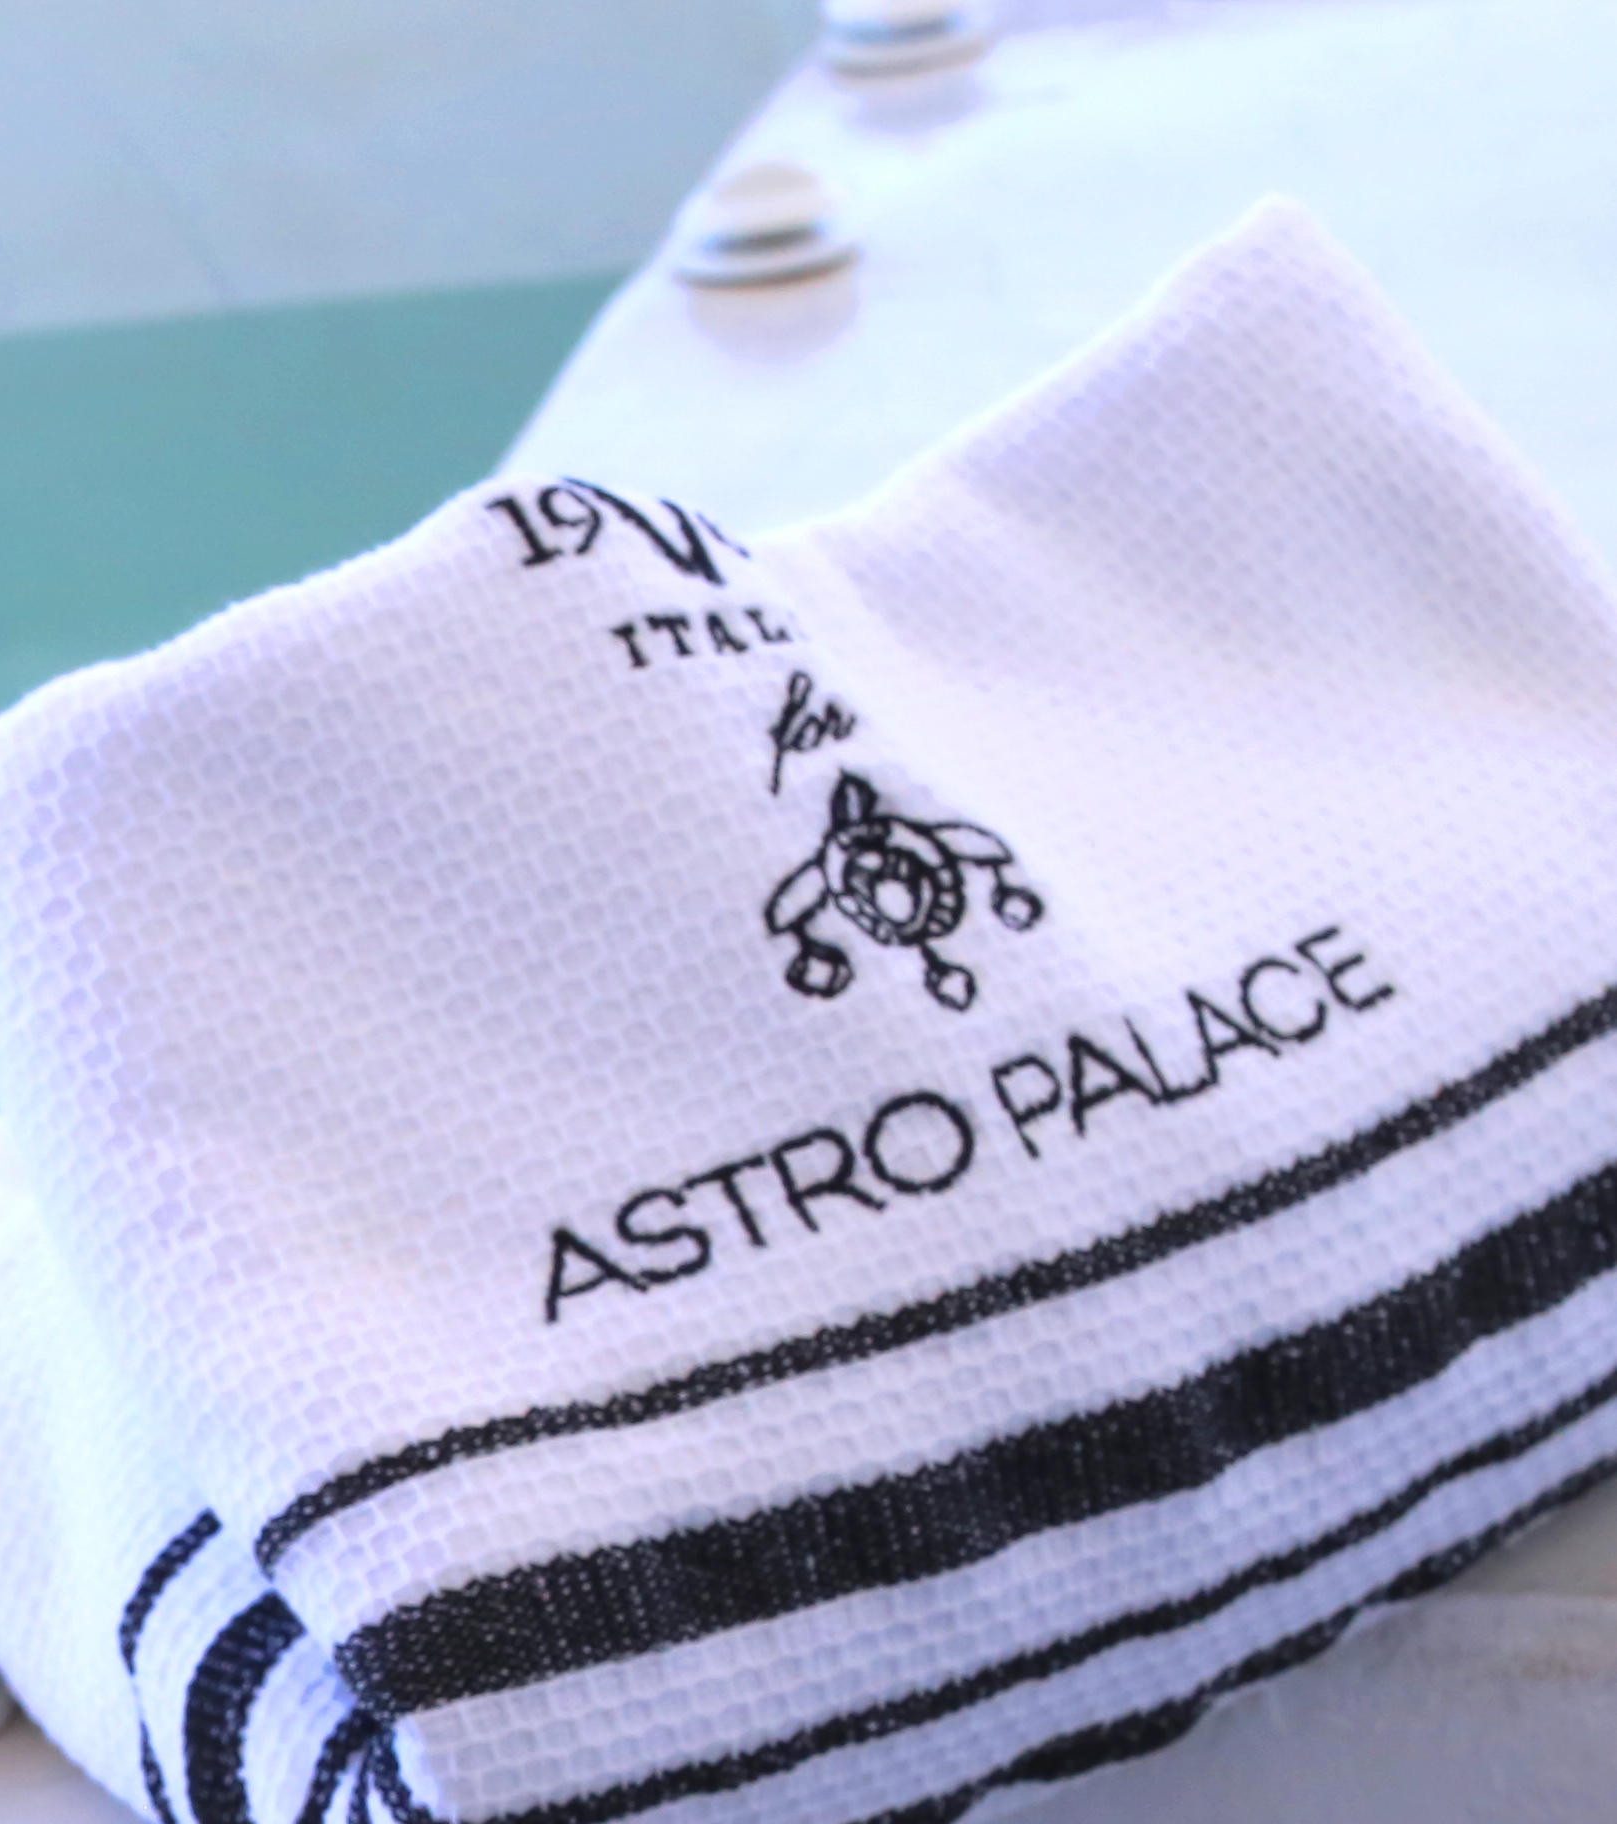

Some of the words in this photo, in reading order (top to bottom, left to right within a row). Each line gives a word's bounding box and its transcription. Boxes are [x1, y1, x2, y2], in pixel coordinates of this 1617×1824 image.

[484, 475, 751, 587] 19V
[610, 605, 807, 668] ITAL
[768, 670, 858, 797] for
[543, 1089, 975, 1324] ASTRO
[990, 925, 1397, 1160] PALACE
